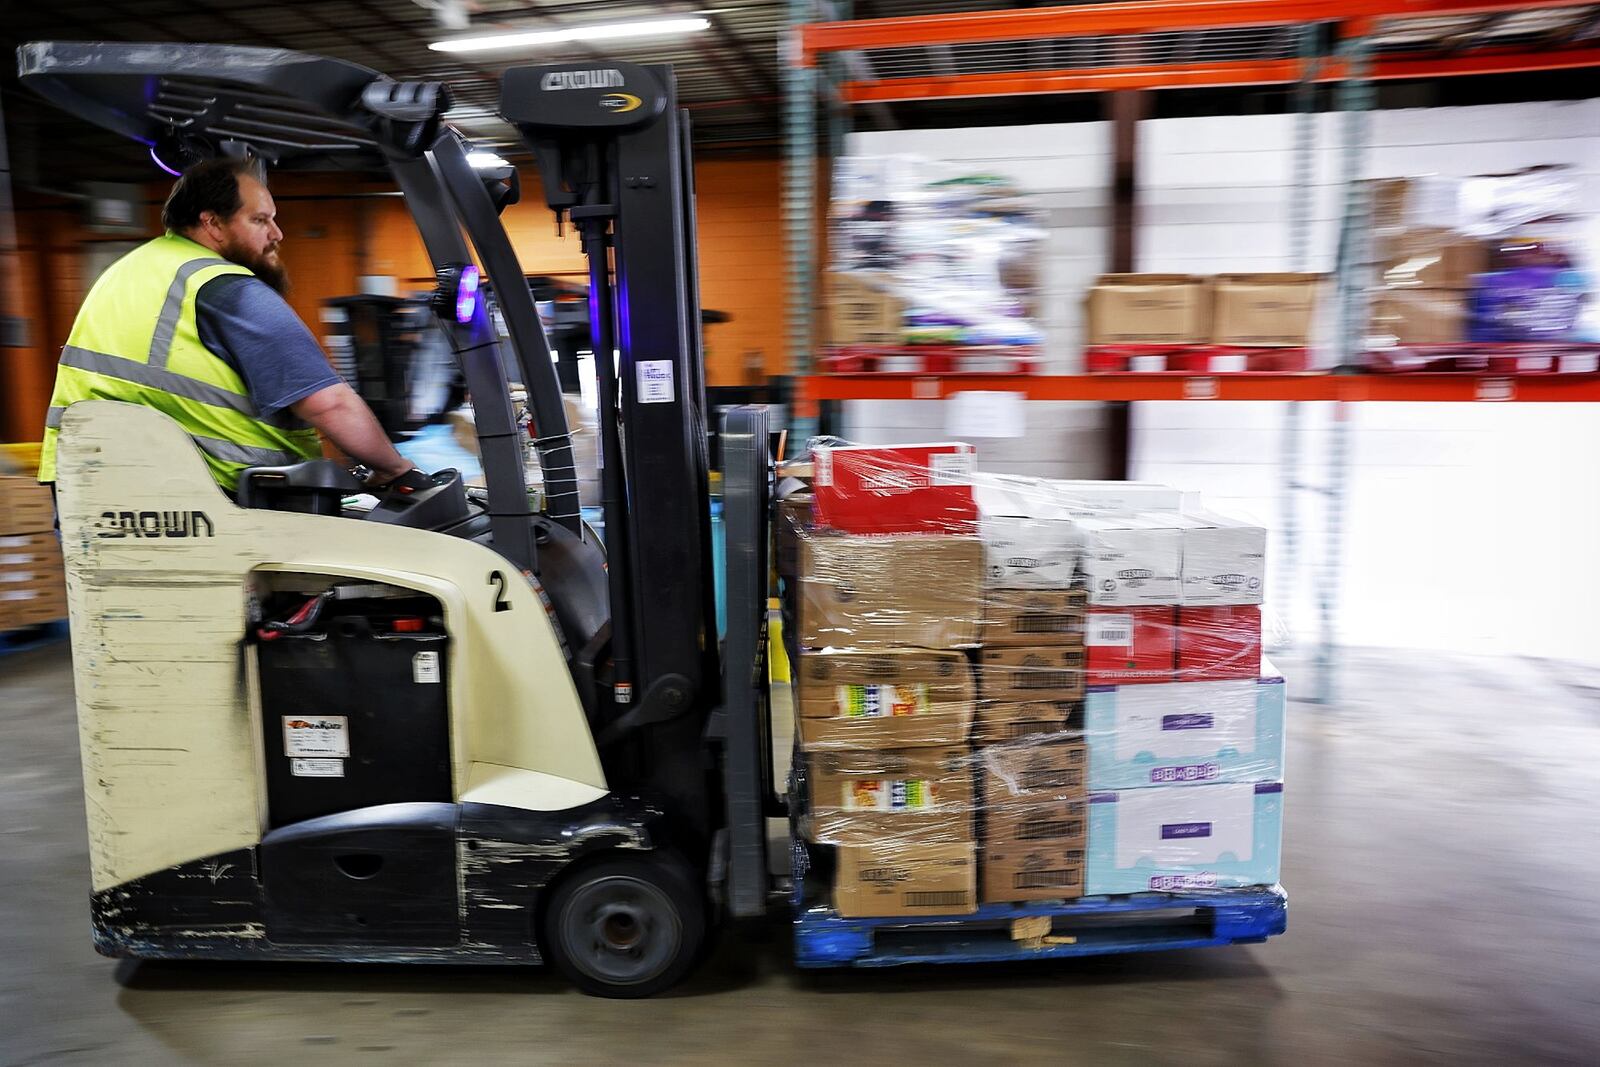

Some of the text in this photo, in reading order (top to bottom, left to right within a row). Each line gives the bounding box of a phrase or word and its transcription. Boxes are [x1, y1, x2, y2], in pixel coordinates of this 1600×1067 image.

[540, 69, 625, 91] CROWN
[97, 511, 215, 538] CROWN
[486, 570, 513, 613] 2
